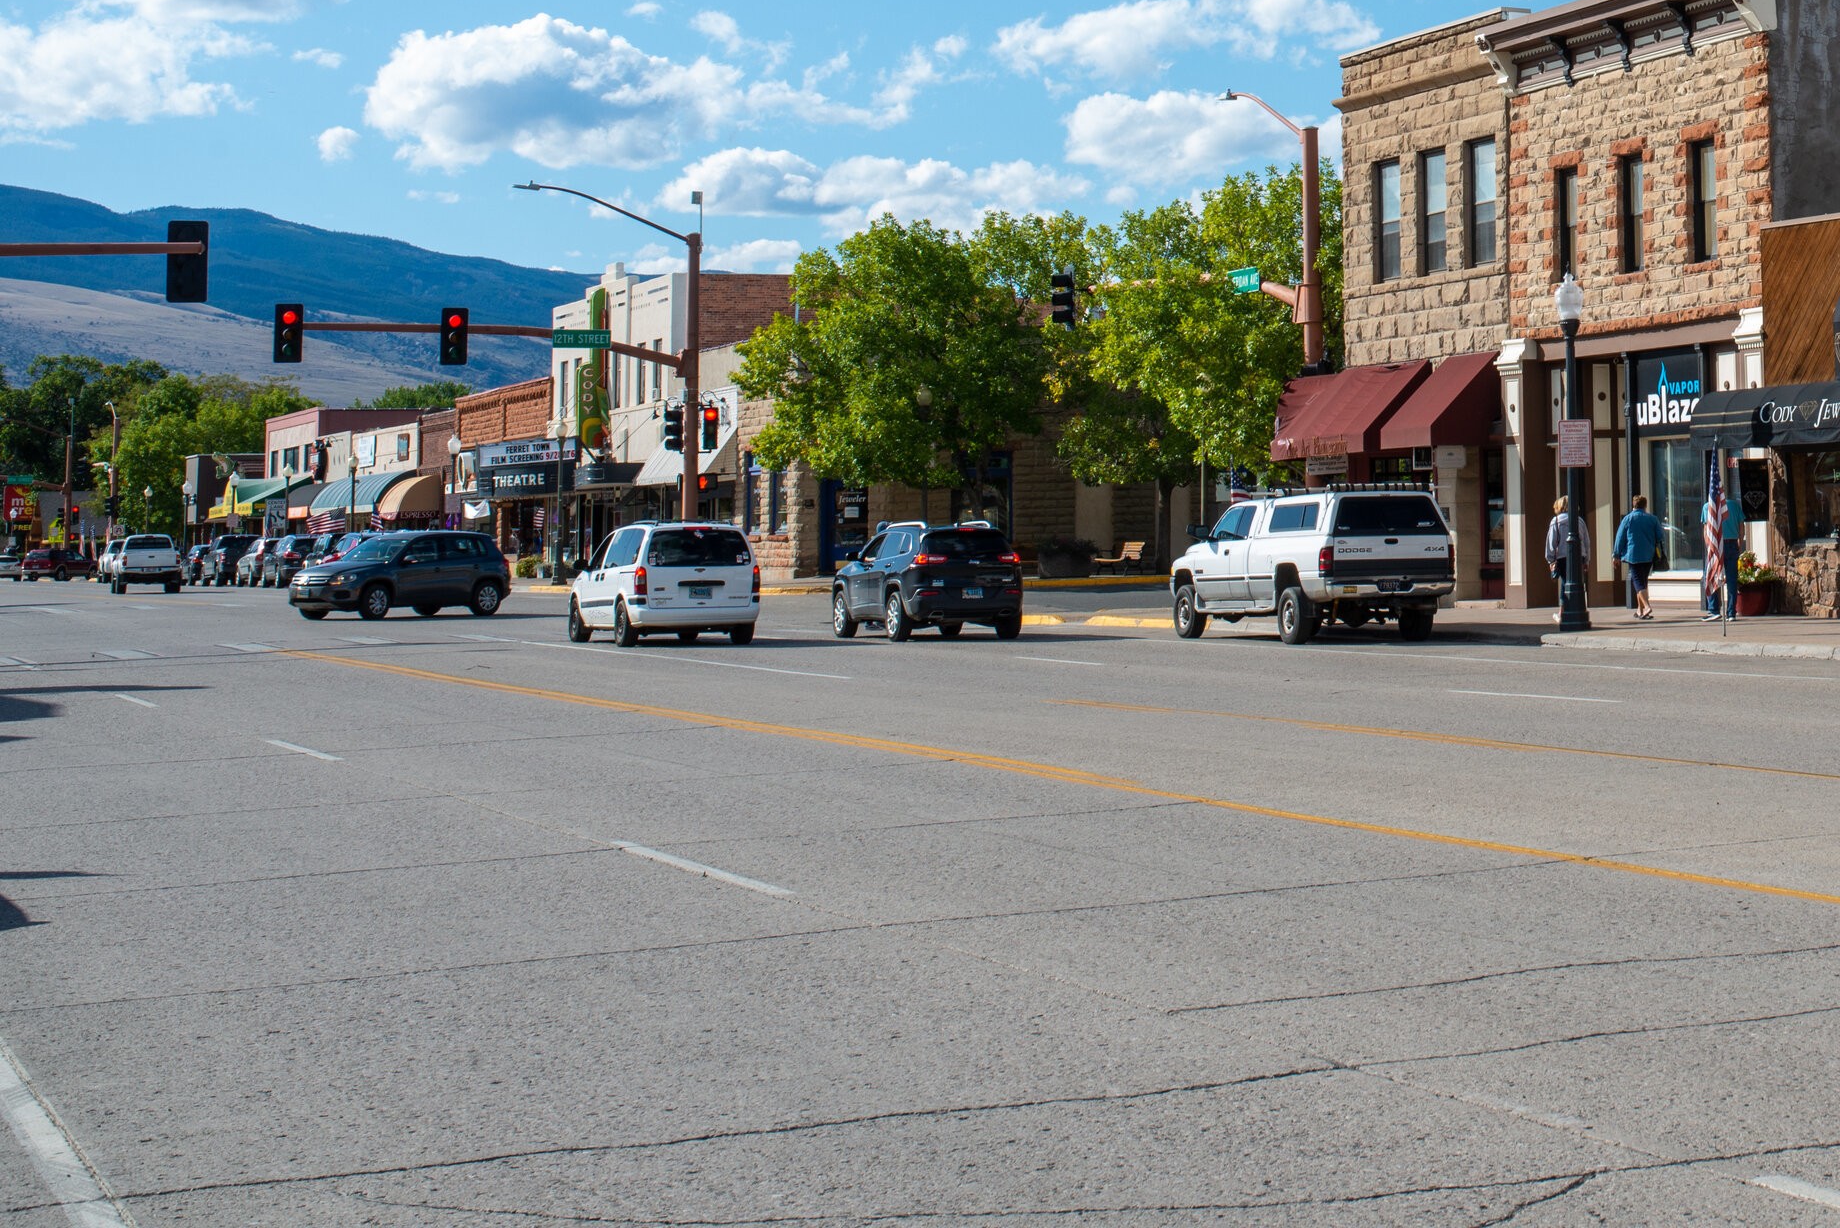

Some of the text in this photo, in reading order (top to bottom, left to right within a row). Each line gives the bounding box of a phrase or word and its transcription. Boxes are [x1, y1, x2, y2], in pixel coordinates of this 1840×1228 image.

[554, 334, 610, 344] 12TH STREET
[583, 368, 594, 415] CODY
[1669, 380, 1699, 395] VAPOR
[506, 444, 550, 454] FERRET TOWN
[491, 456, 506, 464] FILM
[509, 453, 544, 464] SCREENING
[545, 451, 560, 460] 9/2
[492, 473, 545, 488] THEATRE
[839, 494, 867, 504] Jeweler
[400, 511, 435, 519] ESPRESSO
